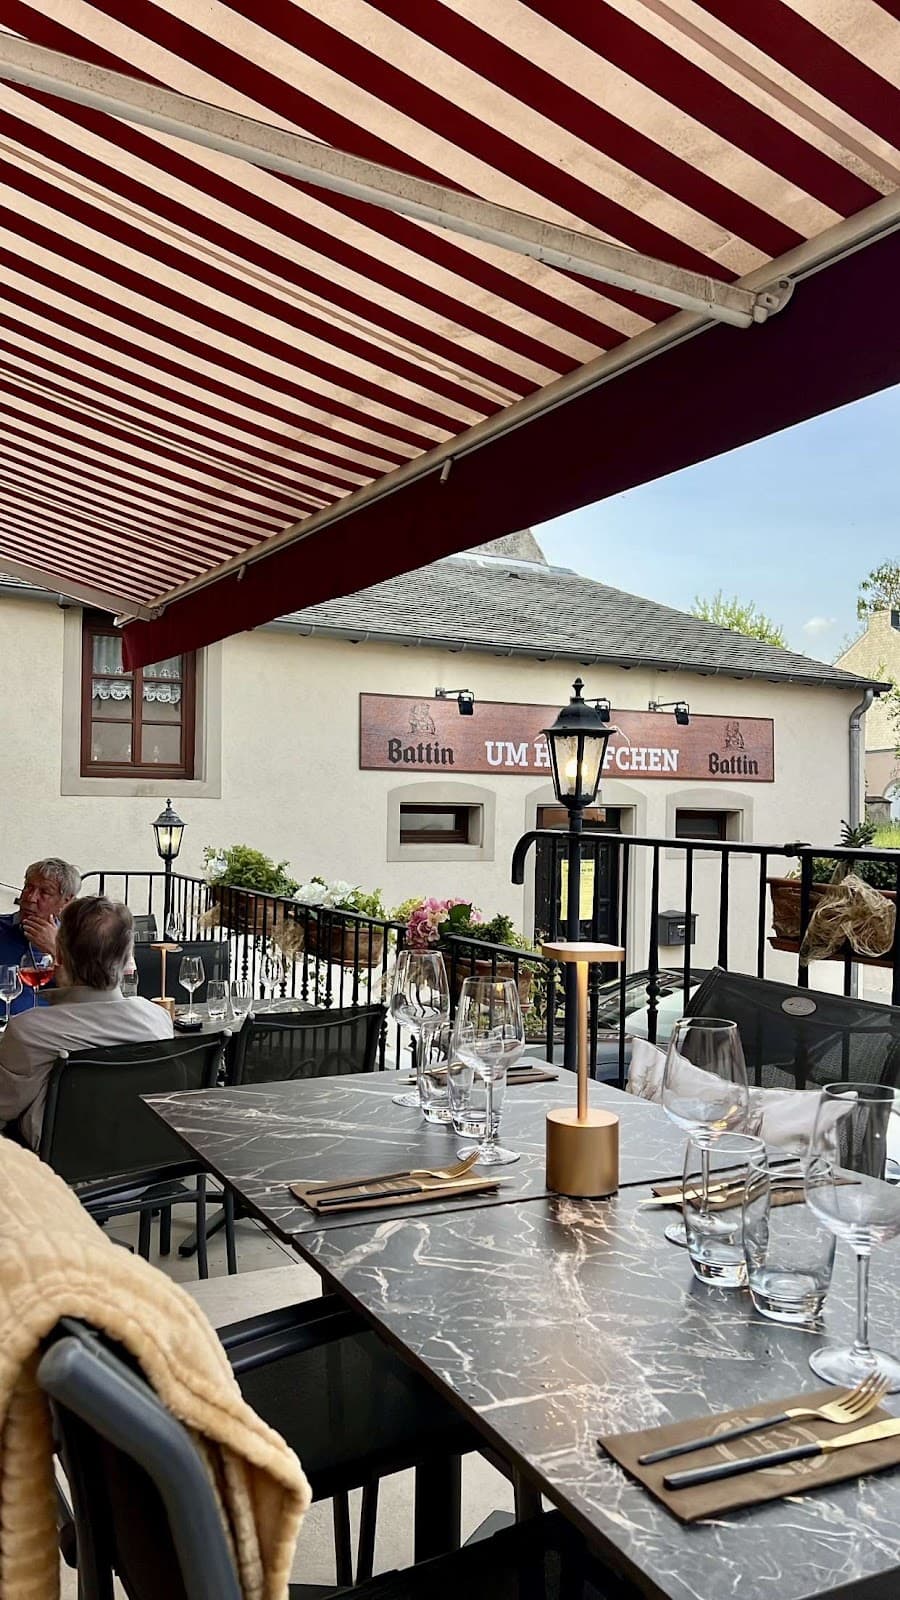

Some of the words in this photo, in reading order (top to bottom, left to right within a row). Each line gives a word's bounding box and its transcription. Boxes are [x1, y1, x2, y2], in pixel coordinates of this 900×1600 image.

[388, 738, 455, 765] Battin
[484, 741, 529, 766] UM
[708, 752, 759, 775] Battin
